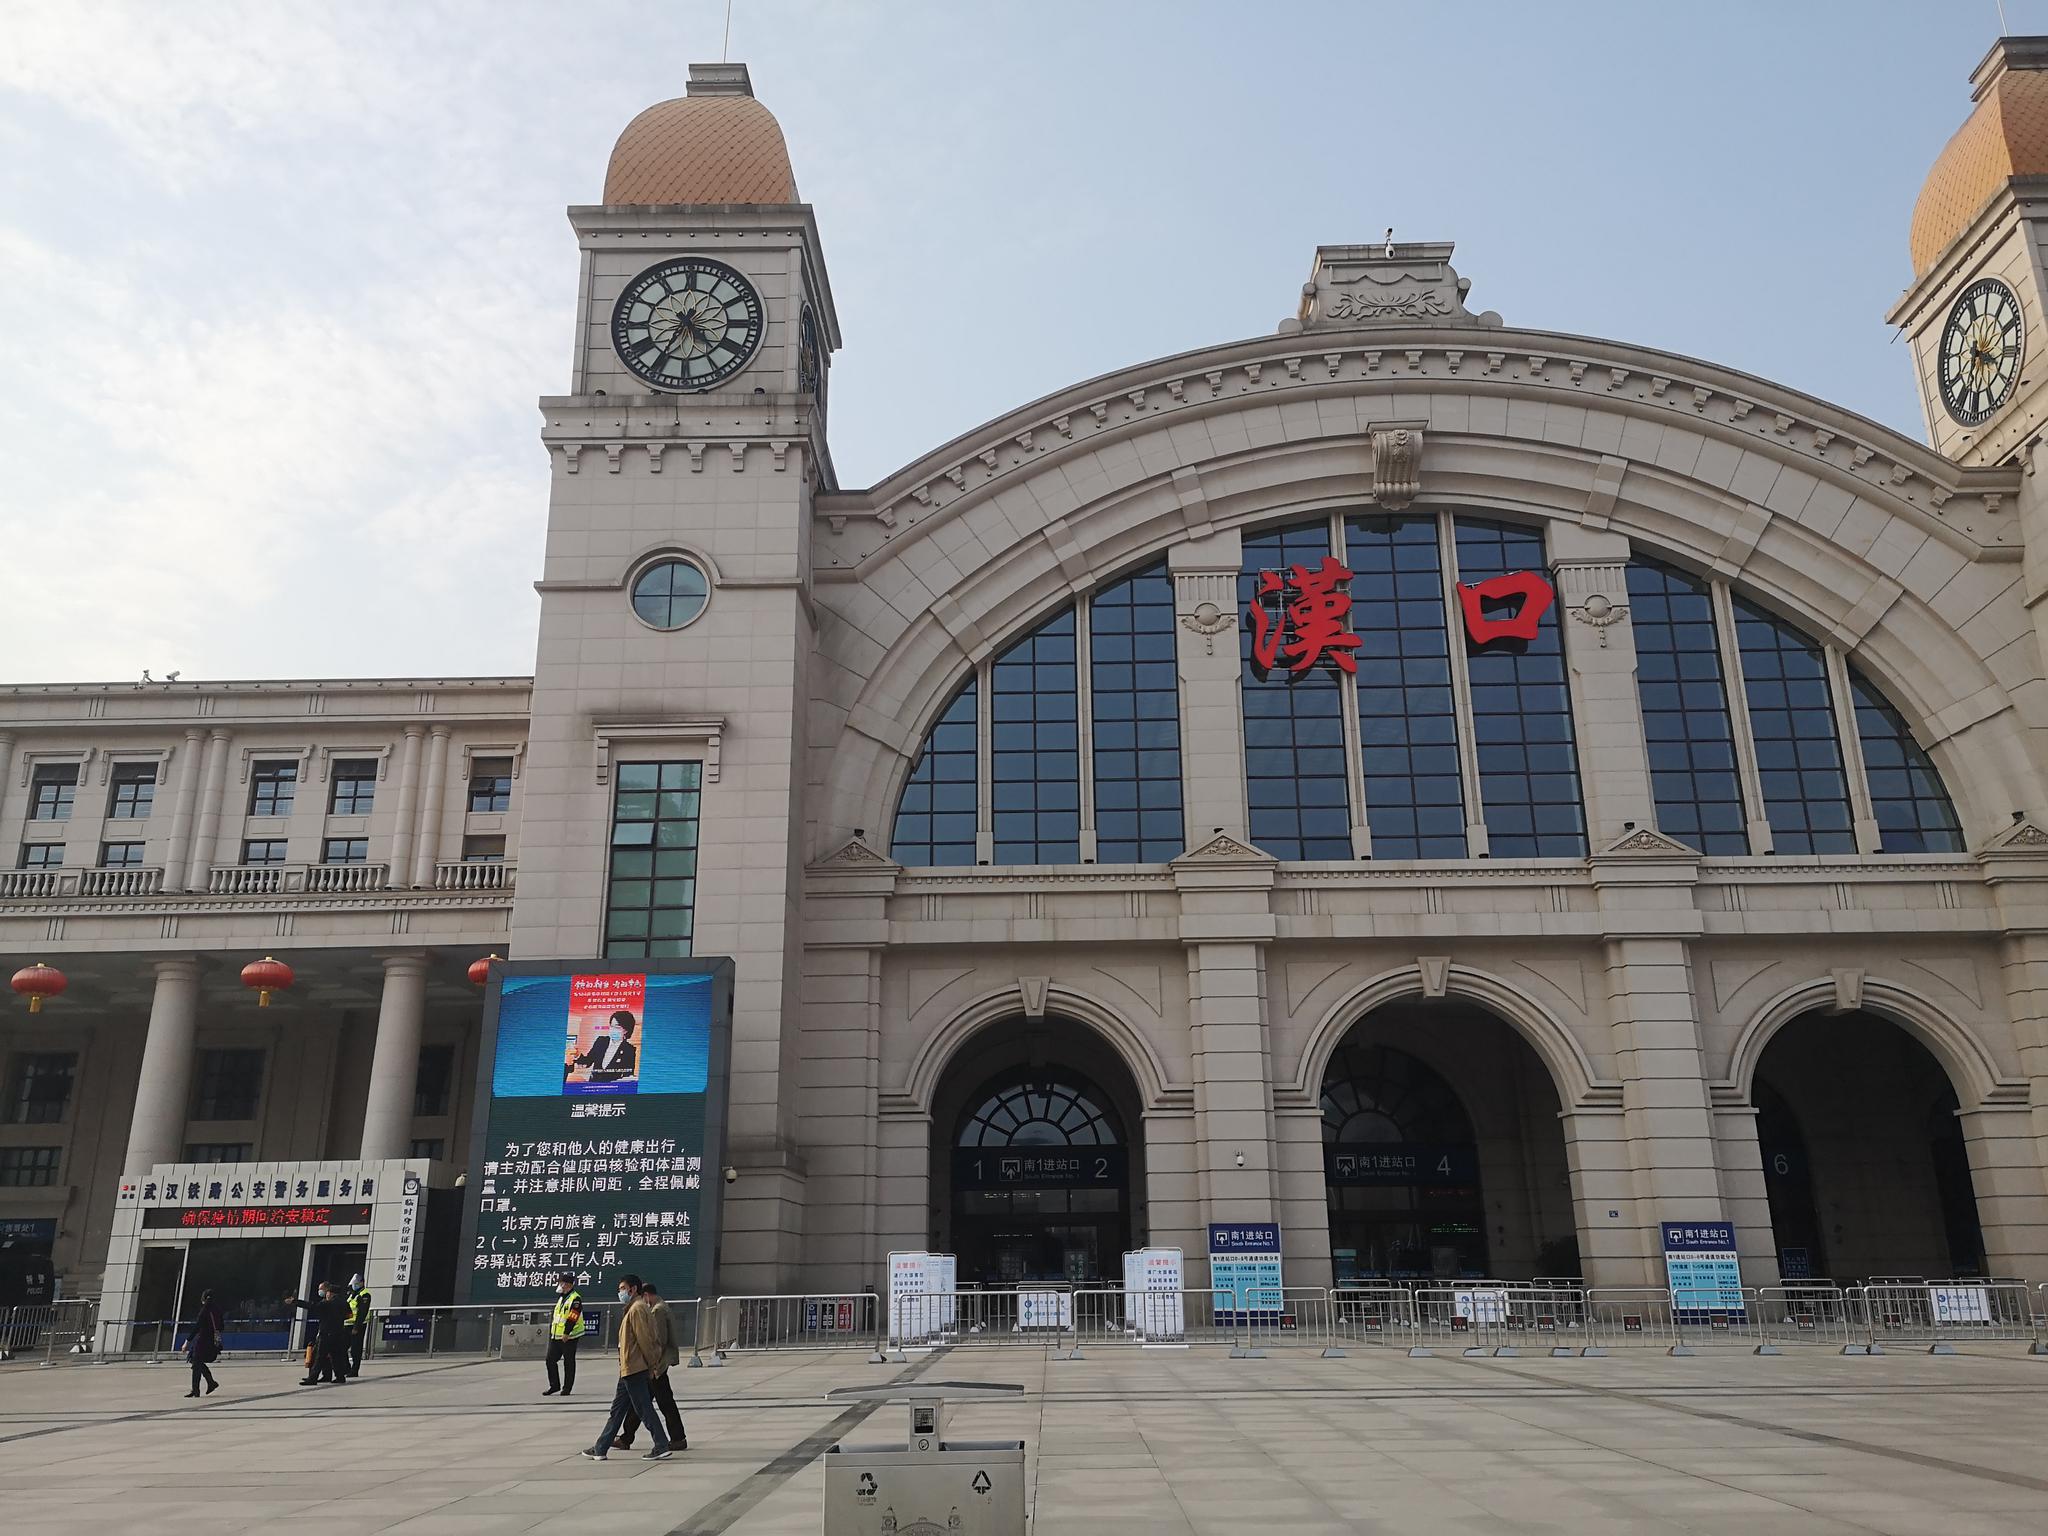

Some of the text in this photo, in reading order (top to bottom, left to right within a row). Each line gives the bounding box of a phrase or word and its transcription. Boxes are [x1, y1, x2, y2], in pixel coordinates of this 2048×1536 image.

[1252, 556, 1555, 673] 漢口
[570, 1102, 626, 1118] 温馨提示
[504, 1138, 686, 1157] 为了您和他人的健康出行，
[483, 1156, 701, 1176] 请主动配合健康码核验和体温测
[973, 1158, 1108, 1181] 1 南1进站口 2
[1359, 1154, 1451, 1176] 南1进站口 4
[1774, 1153, 1789, 1175] 6
[143, 1178, 374, 1200] 武汉铁路公安警务服务岗
[481, 1173, 701, 1195] 量，并注意排队间距，全程佩戴
[480, 1197, 517, 1213] 口罩。
[502, 1211, 691, 1231] 北京方向旅客，请到售票处
[396, 1198, 415, 1282] 临时身份证明办理处
[1231, 1231, 1273, 1240] 南1进站口
[1685, 1229, 1728, 1239] 南1进站口
[473, 1250, 624, 1270] 务驿站联系工作人员。
[496, 1270, 603, 1288] 谢谢您的合！
